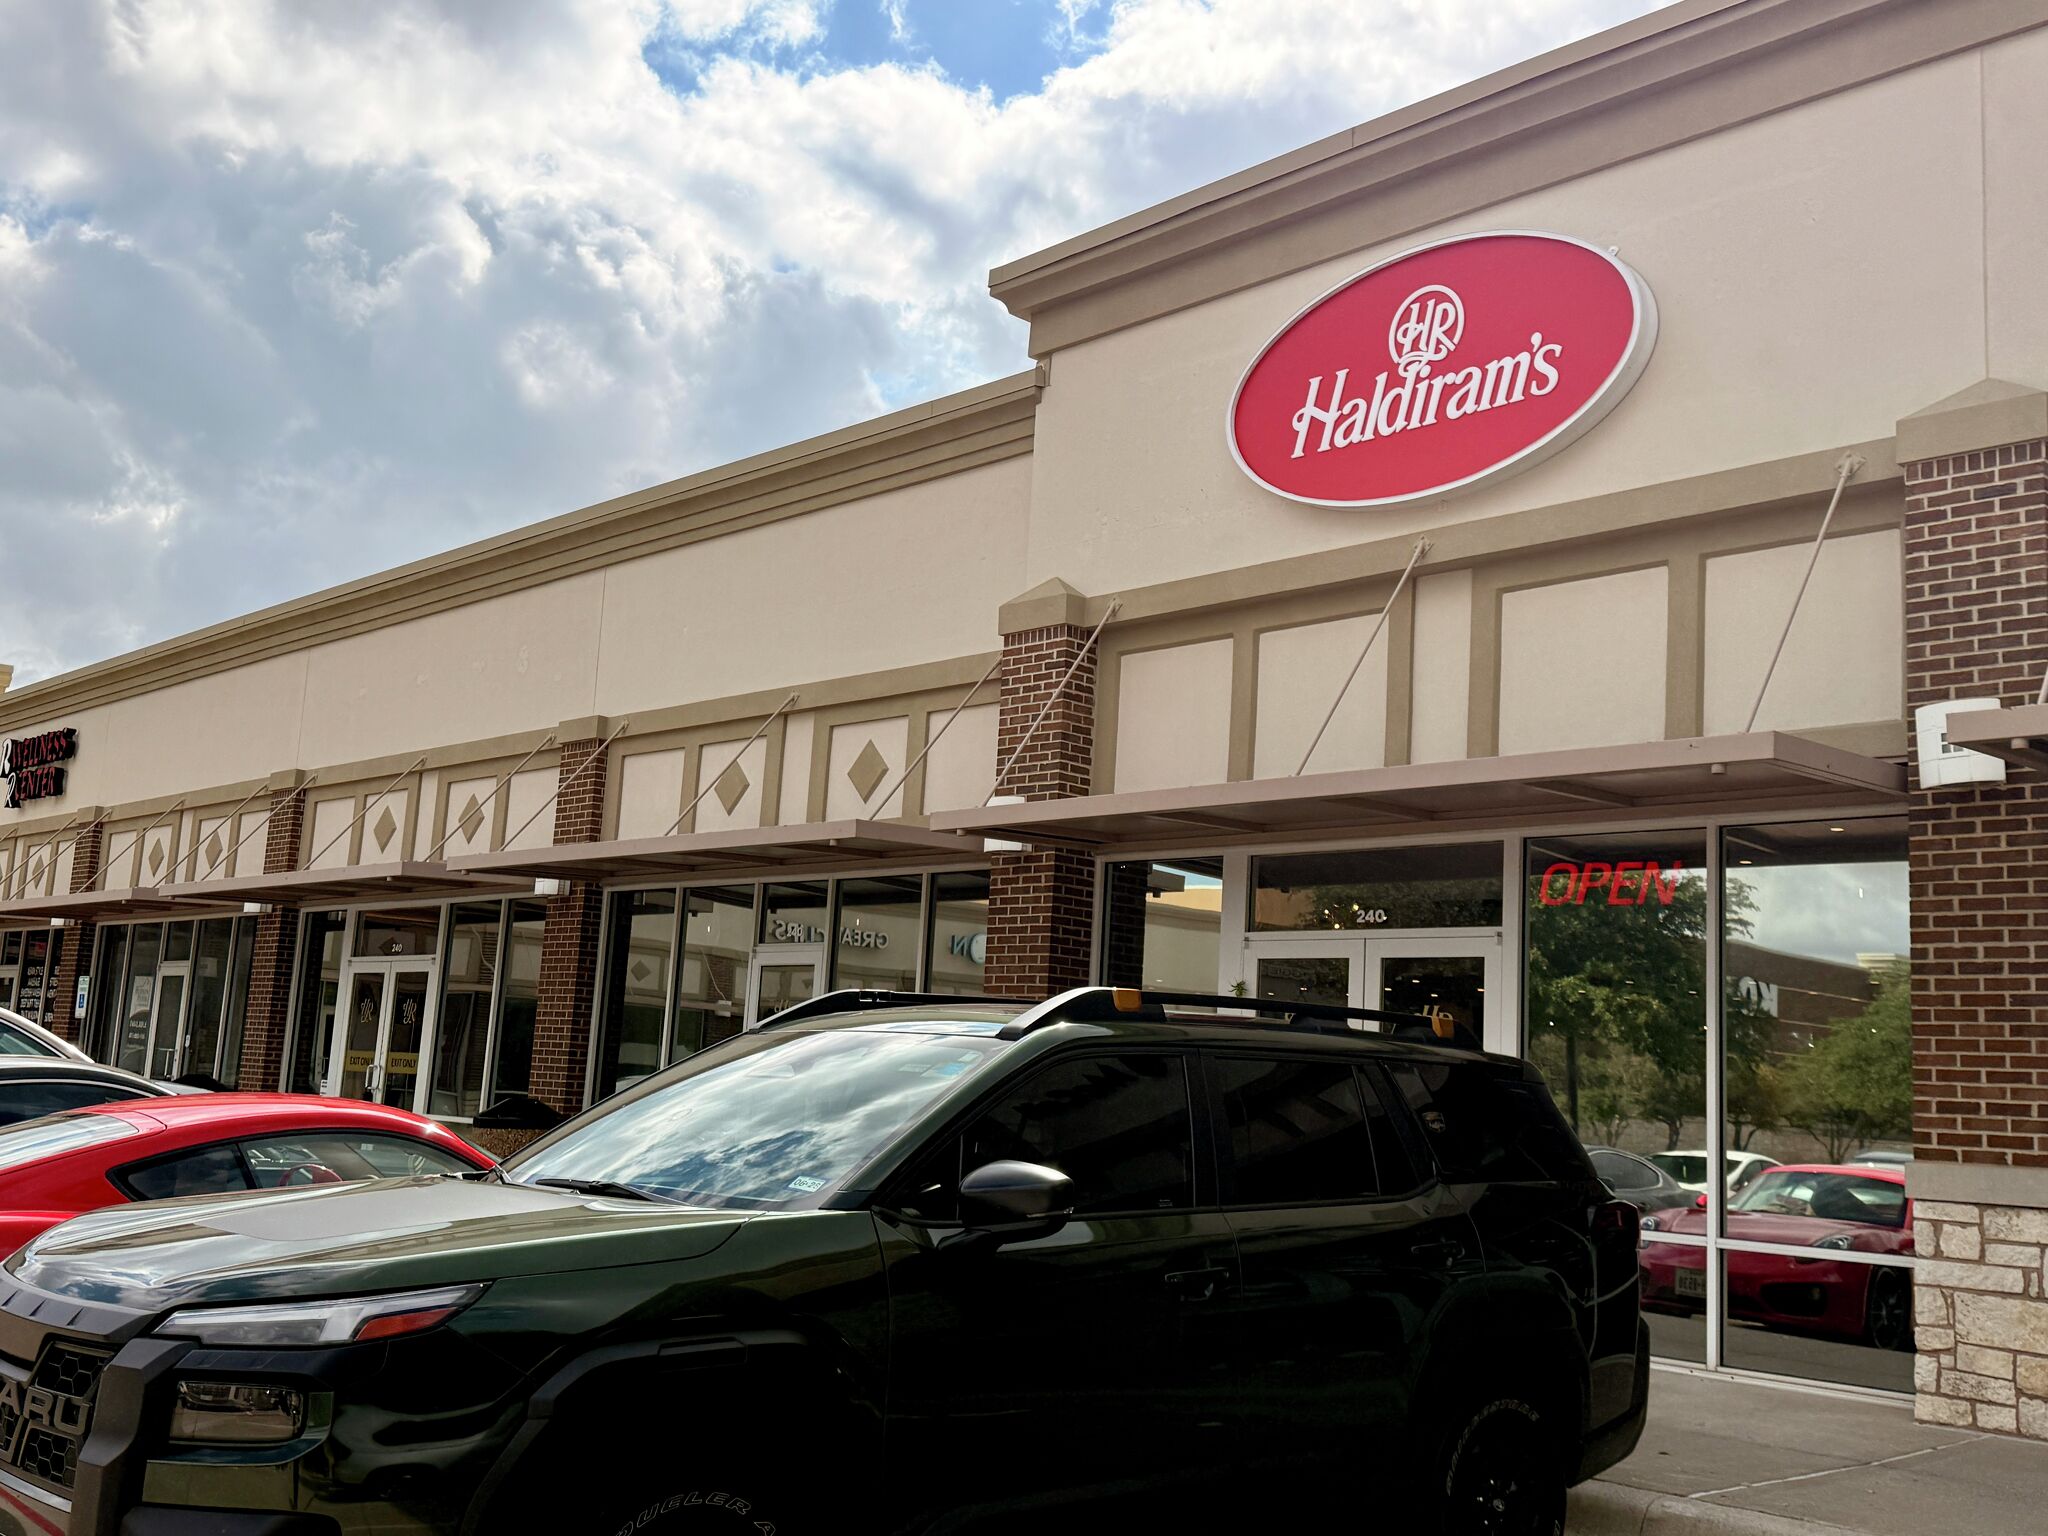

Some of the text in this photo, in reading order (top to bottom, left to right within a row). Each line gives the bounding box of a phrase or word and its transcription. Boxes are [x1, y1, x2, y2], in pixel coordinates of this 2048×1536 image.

[1291, 332, 1563, 458] Haldiram's
[15, 766, 64, 801] CENTER
[1539, 860, 1682, 906] OPEN
[1356, 909, 1385, 923] 240
[391, 943, 403, 953] 240
